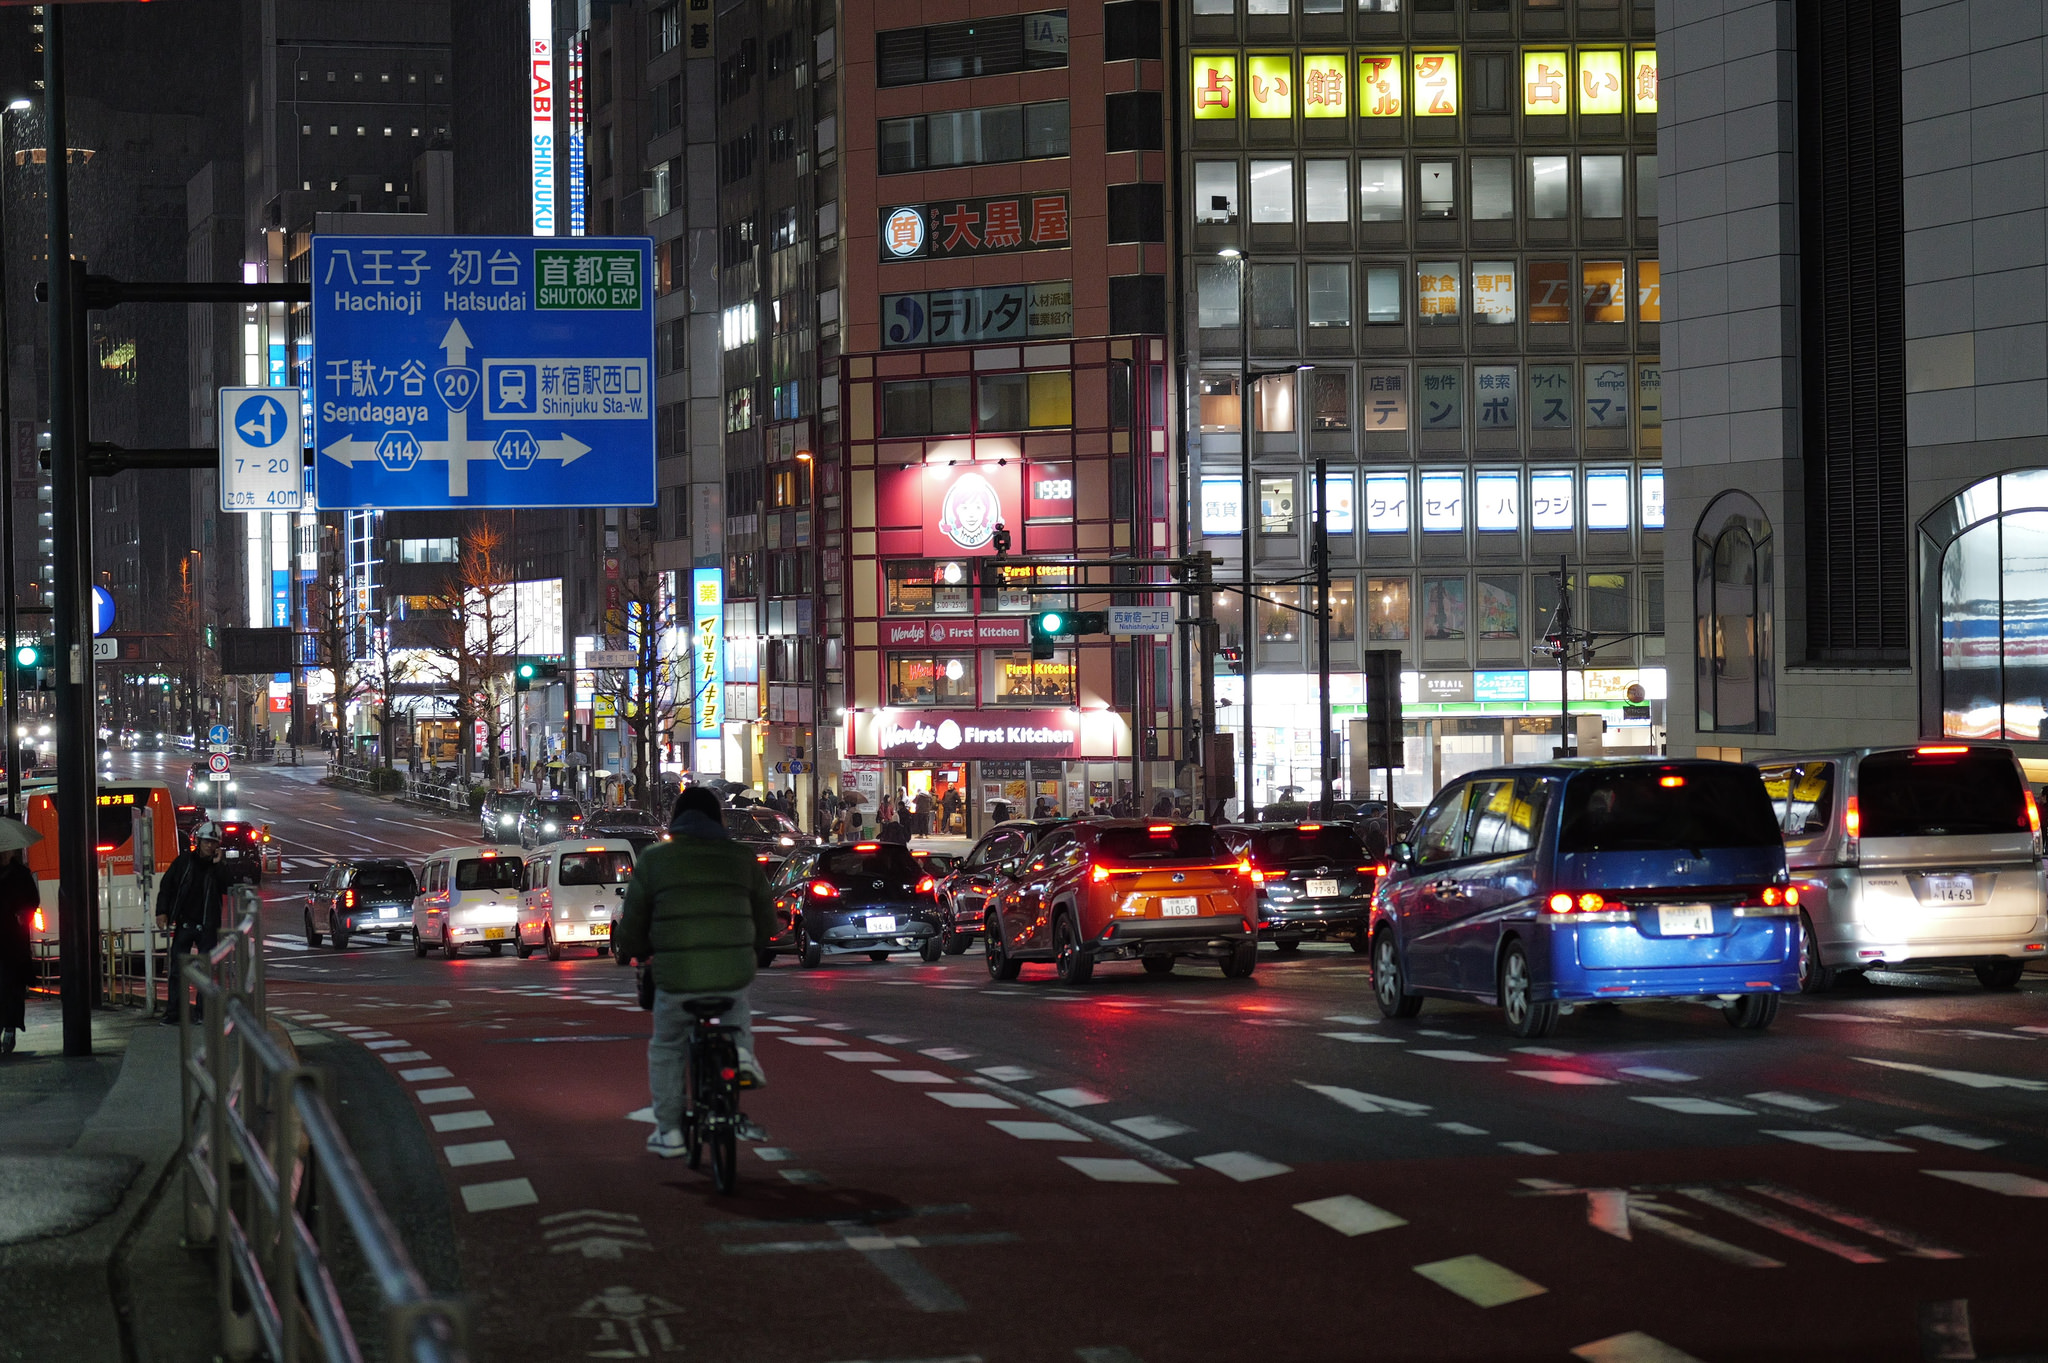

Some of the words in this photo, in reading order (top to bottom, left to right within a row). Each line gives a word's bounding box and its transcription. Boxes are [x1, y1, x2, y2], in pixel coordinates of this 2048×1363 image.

[532, 60, 551, 122] LABI
[1197, 68, 1343, 109] 占い館
[533, 135, 553, 229] SHINJUKU
[891, 215, 918, 249] 質
[930, 208, 939, 251] チケット
[942, 196, 1068, 251] 大黒屋
[325, 249, 431, 286] 八王子
[449, 249, 522, 286] 初台
[540, 256, 636, 287] 首都高
[1419, 275, 1455, 293] 飲食
[1476, 275, 1512, 292] 専門
[334, 292, 422, 313] Hachioji
[444, 292, 527, 311] Hatsudai
[540, 288, 607, 305] SHUTOKO
[612, 288, 638, 305] EXP
[1029, 292, 1071, 308] 人材派遣
[1420, 297, 1456, 314] 転職
[444, 375, 469, 397] 20
[541, 366, 641, 396] 新宿駅西口
[1370, 374, 1401, 391] 店舗
[1424, 374, 1456, 391] 物件
[1479, 374, 1511, 391] 検索
[1531, 373, 1567, 388] サイト
[323, 401, 429, 424] Sendagaya
[543, 397, 598, 416] Shinjuku
[603, 397, 643, 414] Sta.-W.
[383, 440, 414, 461] 414
[501, 439, 531, 460] 414
[227, 491, 255, 505] この先
[267, 489, 298, 505] 40m
[1205, 501, 1237, 518] 賃貸
[700, 584, 716, 602] 薬
[1114, 611, 1169, 623] 西新宿一丁目
[891, 625, 925, 643] Wendy's
[949, 628, 973, 638] First
[980, 627, 1020, 637] Kitchen
[699, 617, 716, 730] マツモトキヨシ
[910, 663, 945, 679] Wendy's
[1005, 664, 1032, 675] First
[1428, 680, 1464, 688] STRAIL
[880, 719, 936, 750] Wendy's
[964, 727, 1005, 743] First
[1007, 727, 1074, 743] Kitchen
[1941, 889, 1972, 901] 14-69
[1171, 905, 1195, 915] 10-50
